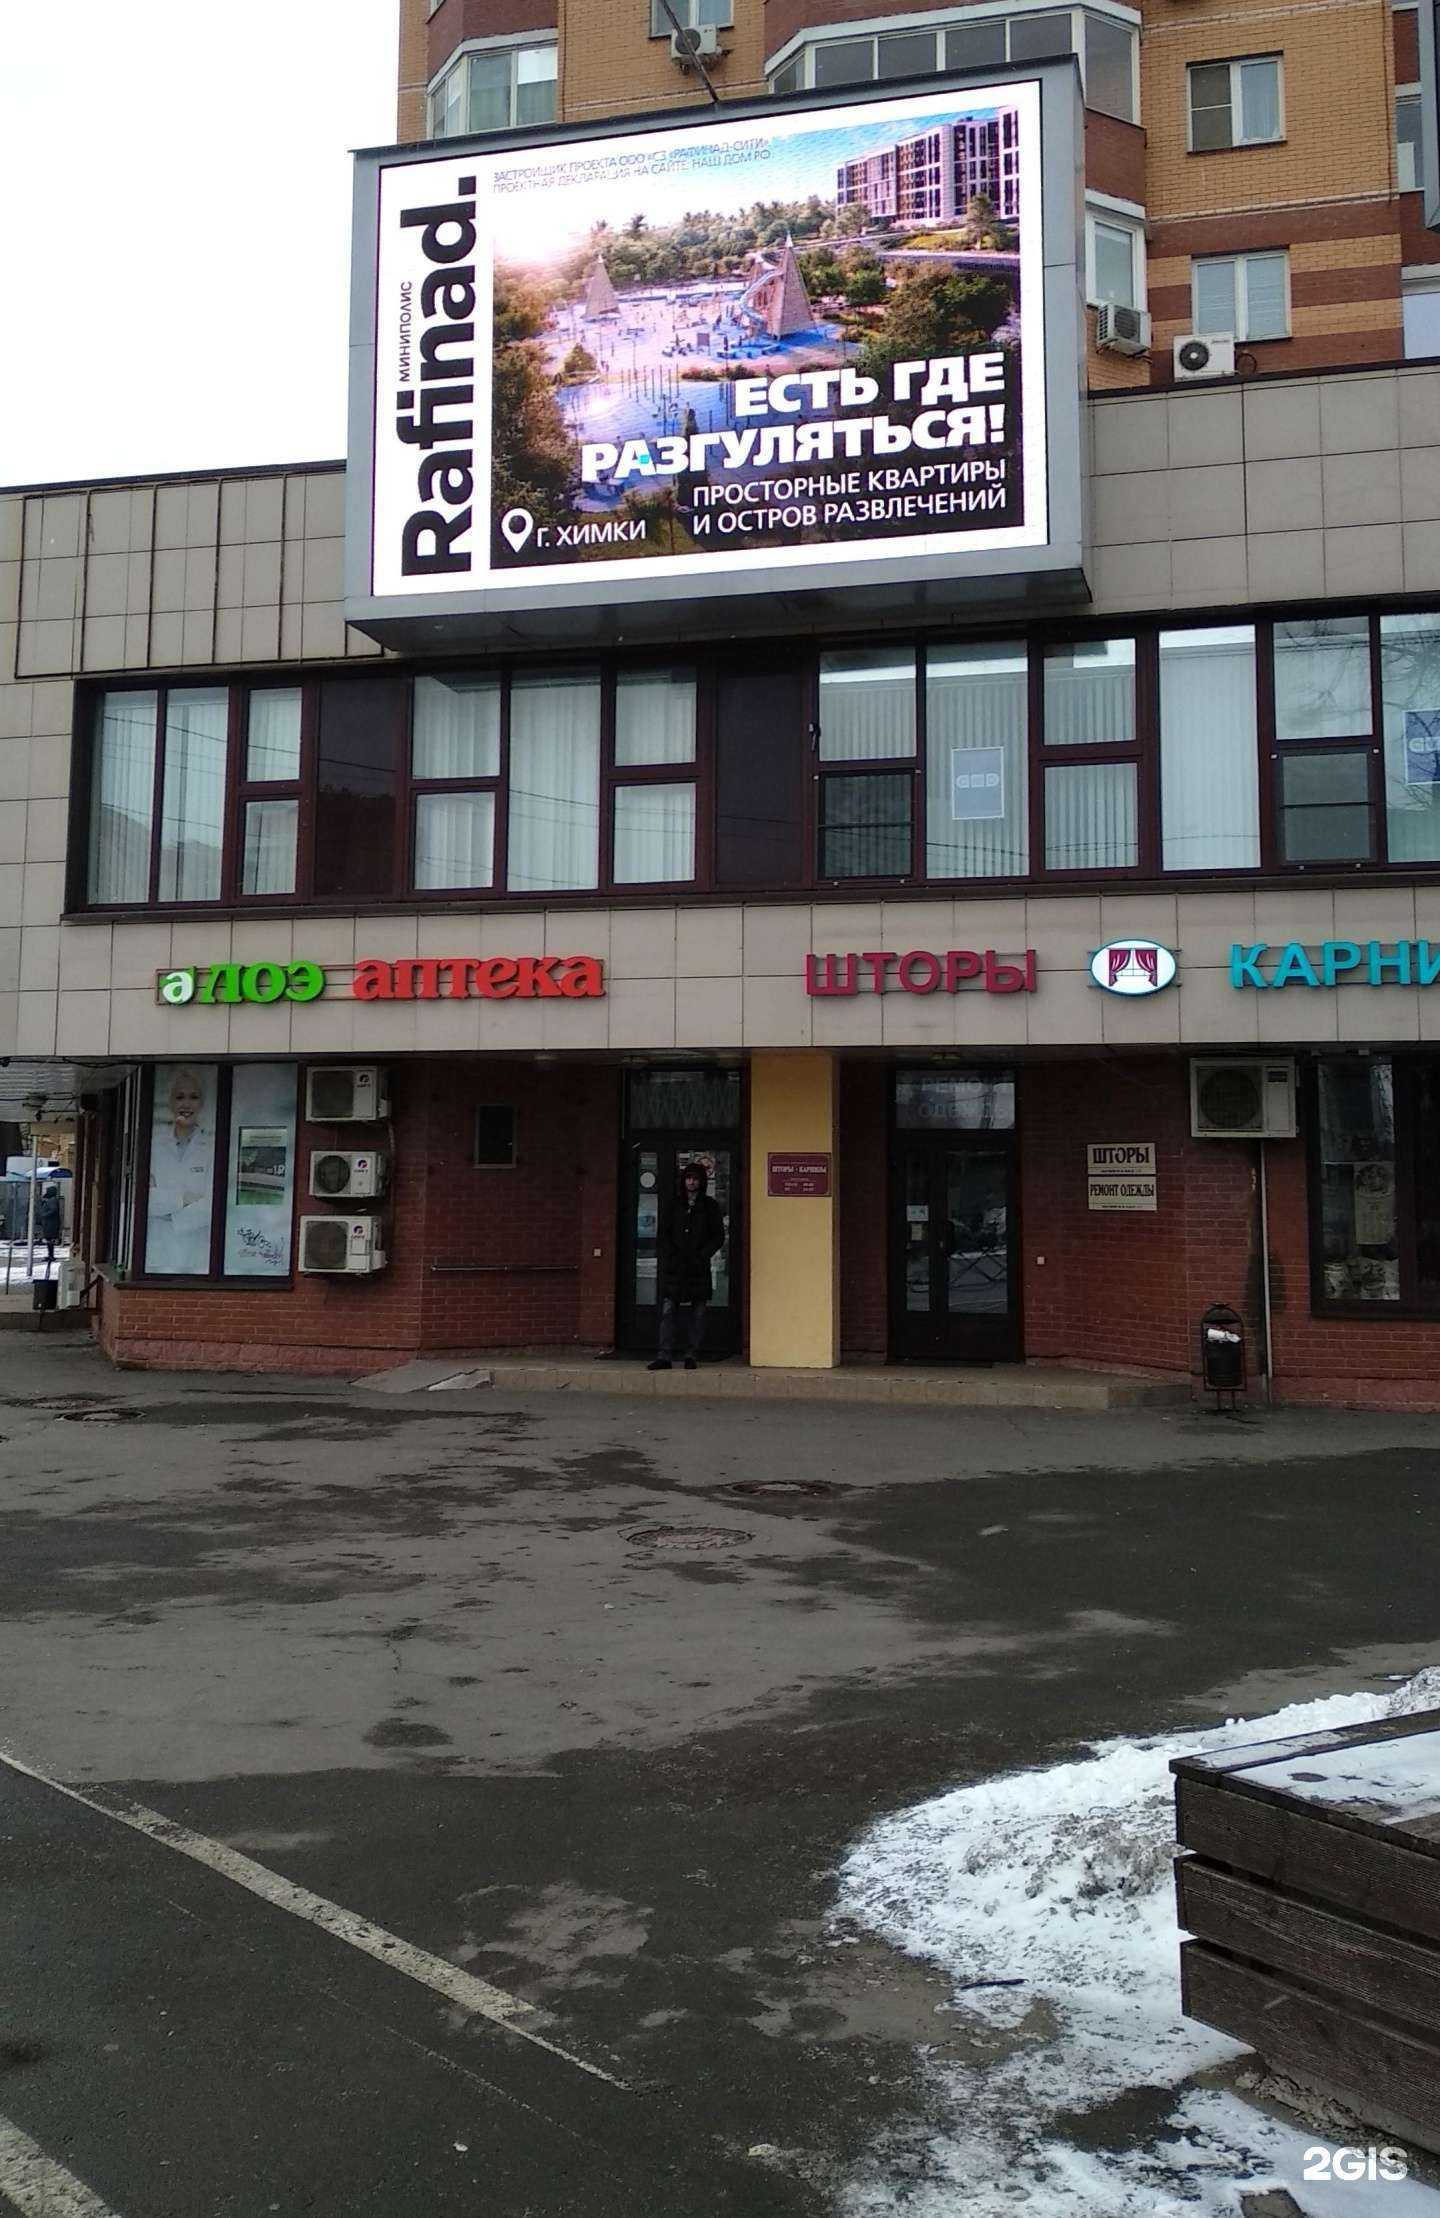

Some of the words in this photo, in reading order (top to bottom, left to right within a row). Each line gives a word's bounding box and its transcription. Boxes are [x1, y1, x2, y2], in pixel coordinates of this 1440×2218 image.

[400, 281, 413, 382] МИНИПОЛИС
[396, 176, 477, 577] Rafinad.
[735, 368, 879, 417] ЕСТЬ
[893, 352, 1005, 406] ГДЕ
[581, 404, 1006, 483] РАЗГУЛЯТЬСЯ!
[693, 473, 861, 507] ПРОСТОРНЫЕ
[868, 459, 1006, 493] КВАРТИРЫ
[556, 519, 647, 546] ХИМКИ
[693, 517, 710, 536] И
[717, 505, 818, 534] ОСТРОВ
[824, 483, 1007, 525] РАЗВЛЕЧЕНИЙ
[161, 959, 327, 1004] алоэ
[352, 956, 606, 1002] аптека
[806, 949, 1037, 997] ШТОРЫ
[1092, 1147, 1150, 1164] ШТОРЫ
[1090, 1184, 1119, 1197] РЕМОНТ
[1120, 1183, 1154, 1197] ОДЕЖДЫ
